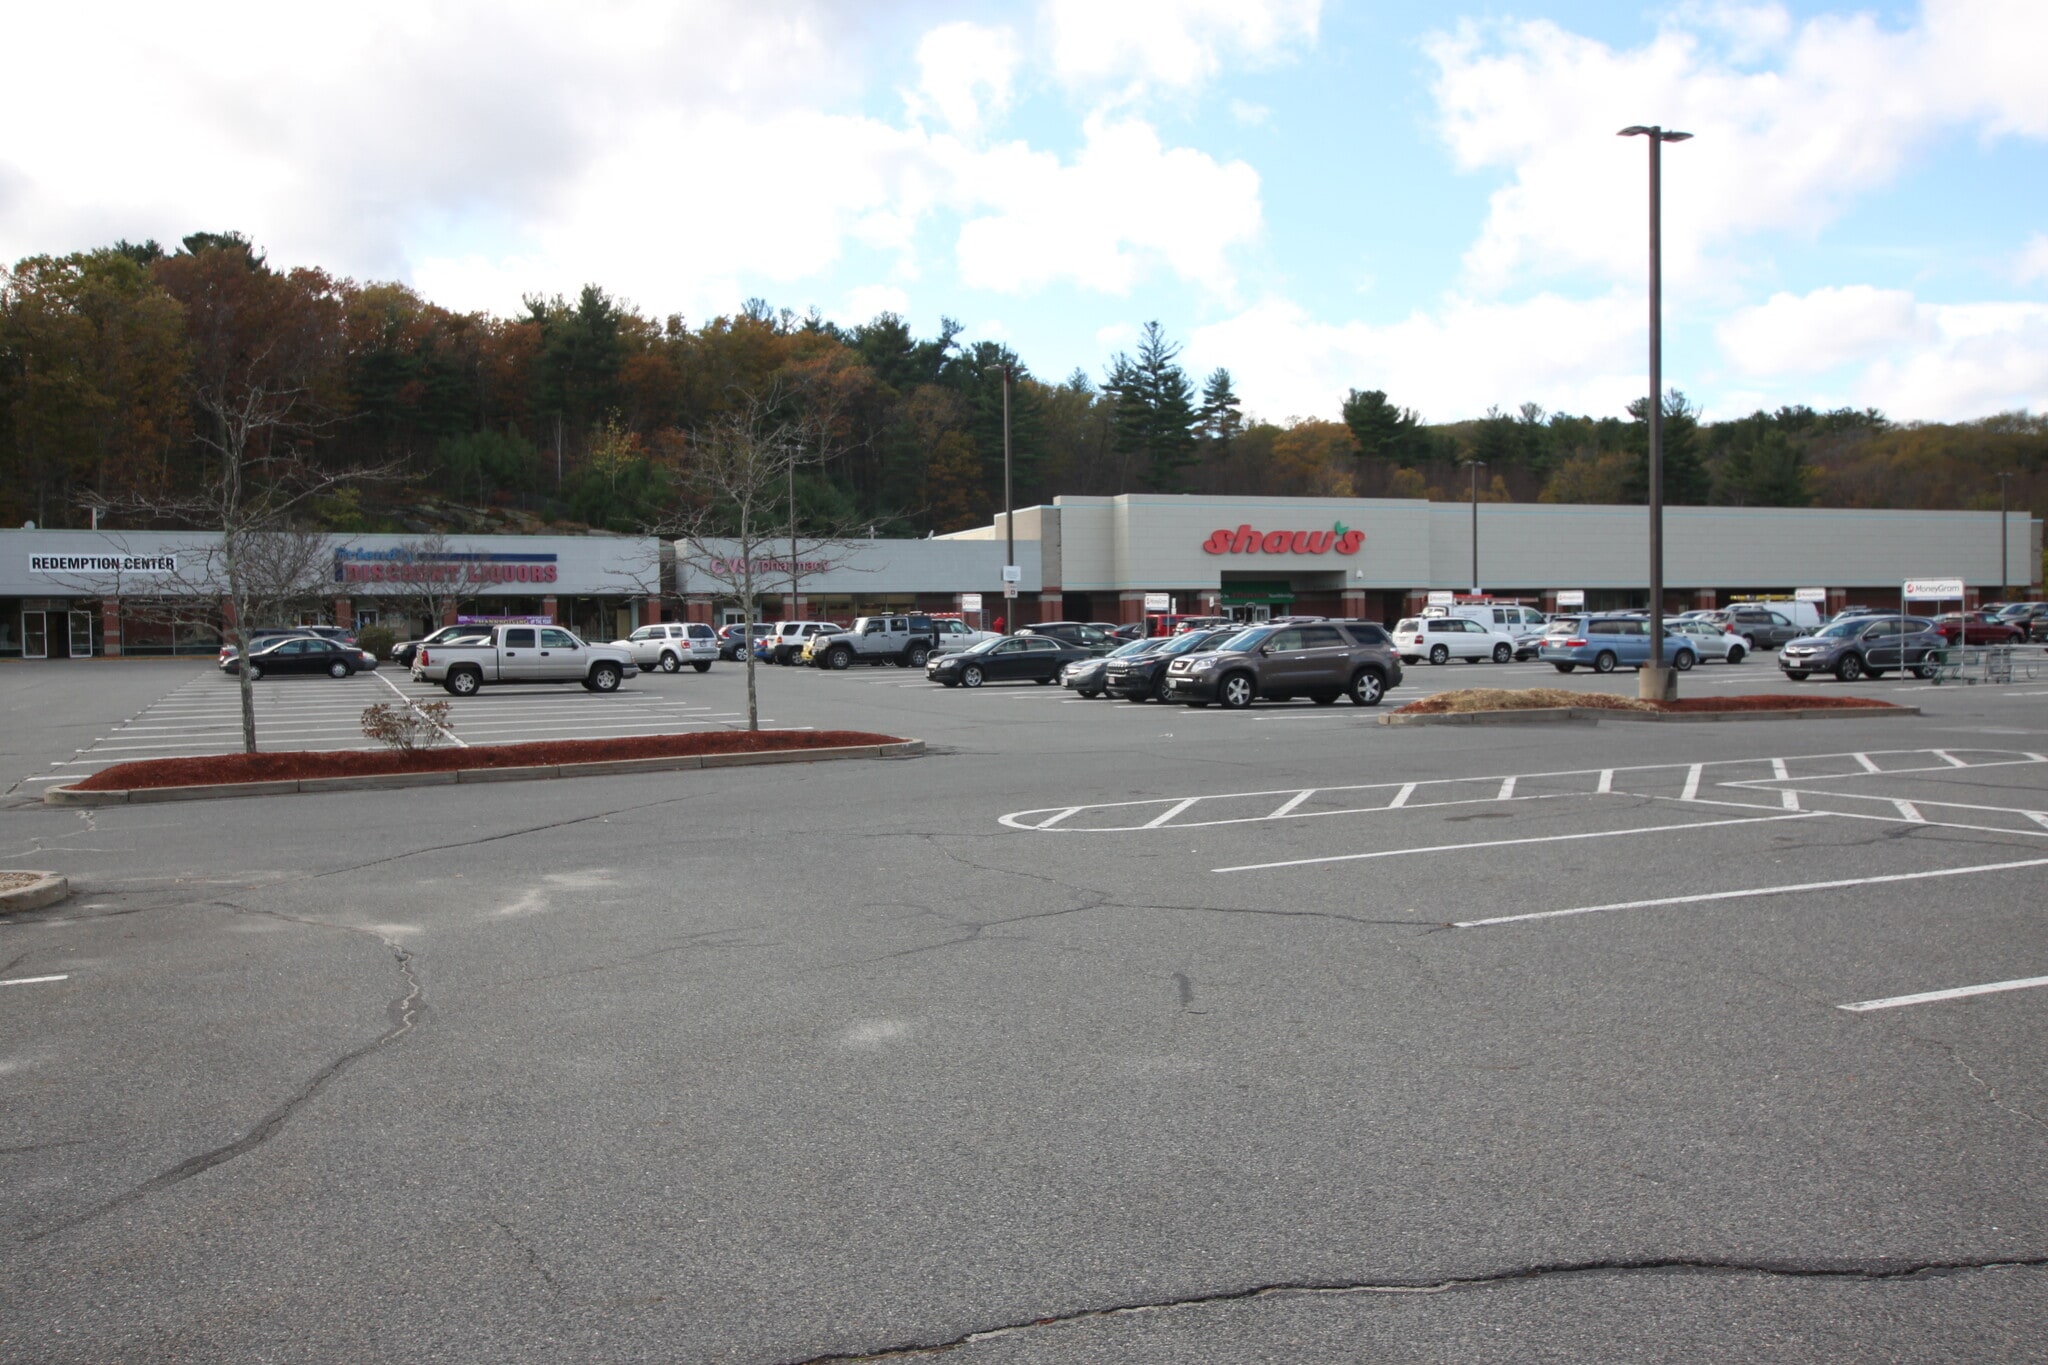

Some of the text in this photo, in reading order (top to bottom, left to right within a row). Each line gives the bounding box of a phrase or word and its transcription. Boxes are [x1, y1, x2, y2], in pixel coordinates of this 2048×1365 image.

[32, 557, 174, 569] REDEMPTION CENTER
[345, 564, 558, 584] DISCOUNT LIQUORS
[1915, 584, 1960, 593] MoneyGram
